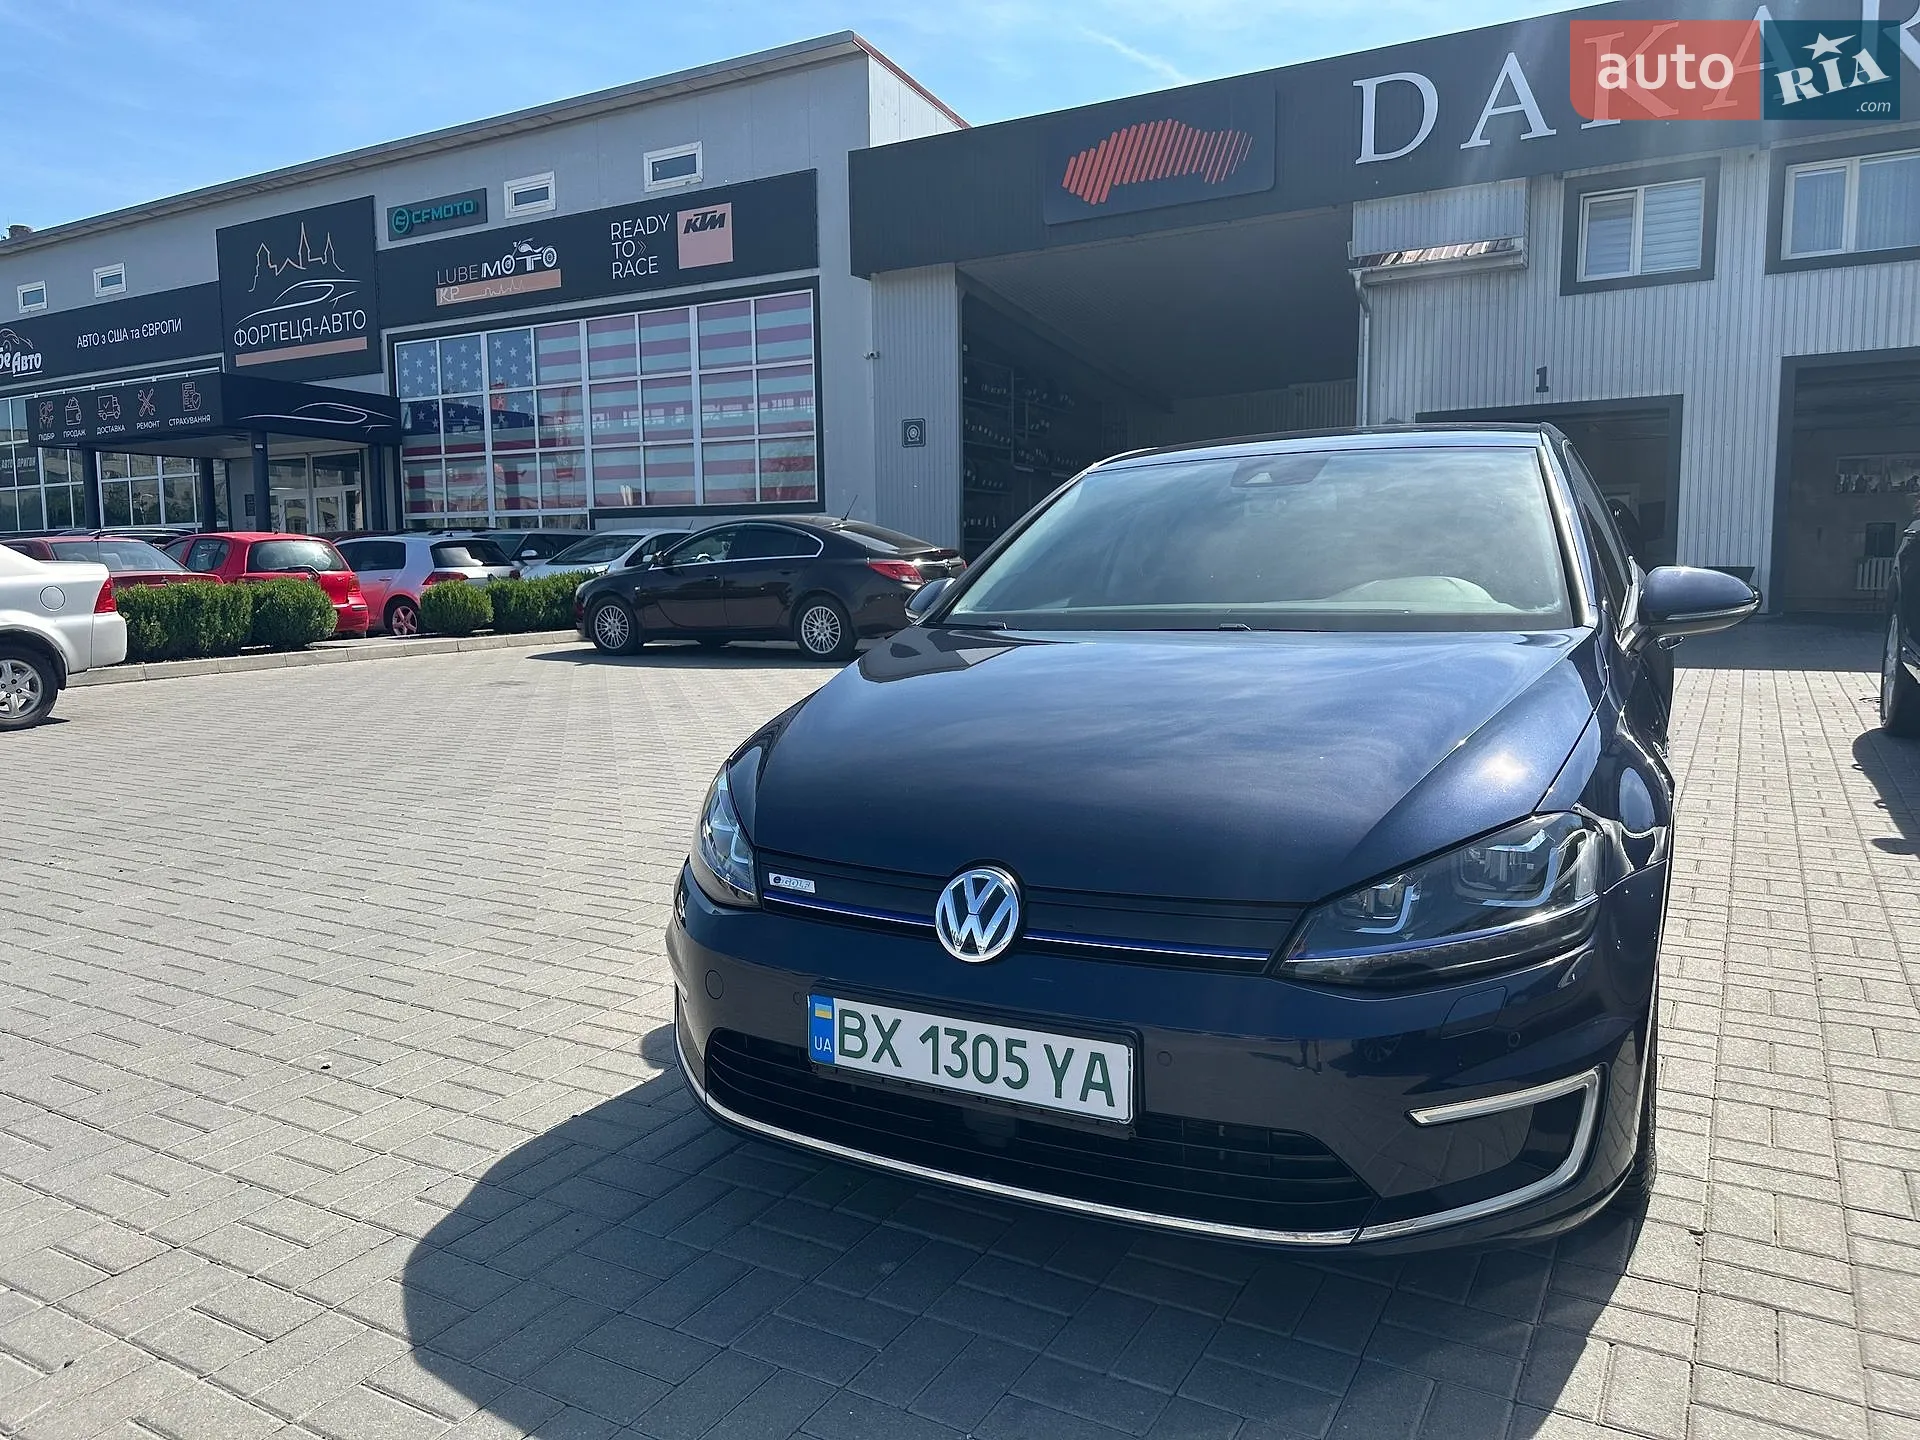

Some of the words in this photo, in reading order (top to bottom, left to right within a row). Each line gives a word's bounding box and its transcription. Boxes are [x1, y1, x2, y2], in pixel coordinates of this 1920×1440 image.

[411, 200, 475, 224] CFMOTO
[683, 210, 726, 235] KTM
[610, 213, 670, 241] READY
[611, 240, 636, 260] TO
[612, 256, 659, 280] RACE
[76, 332, 100, 349] АВТО
[101, 334, 106, 345] з
[107, 327, 129, 344] США
[130, 328, 140, 340] та
[141, 318, 182, 338] ЄВРОПИ
[234, 309, 367, 348] ФОРТЕЦЯ-АВТО
[1535, 366, 1549, 393] 1
[96, 424, 126, 436] ДОСТАВКА
[136, 420, 160, 430] РЕМОНТ
[168, 414, 211, 427] СТРАХУВАННЯ
[63, 428, 87, 439] ПРОДАЖ
[814, 1035, 833, 1053] UA
[838, 1008, 903, 1068] BX
[919, 1024, 1030, 1091] 1305
[1043, 1042, 1116, 1108] YA
